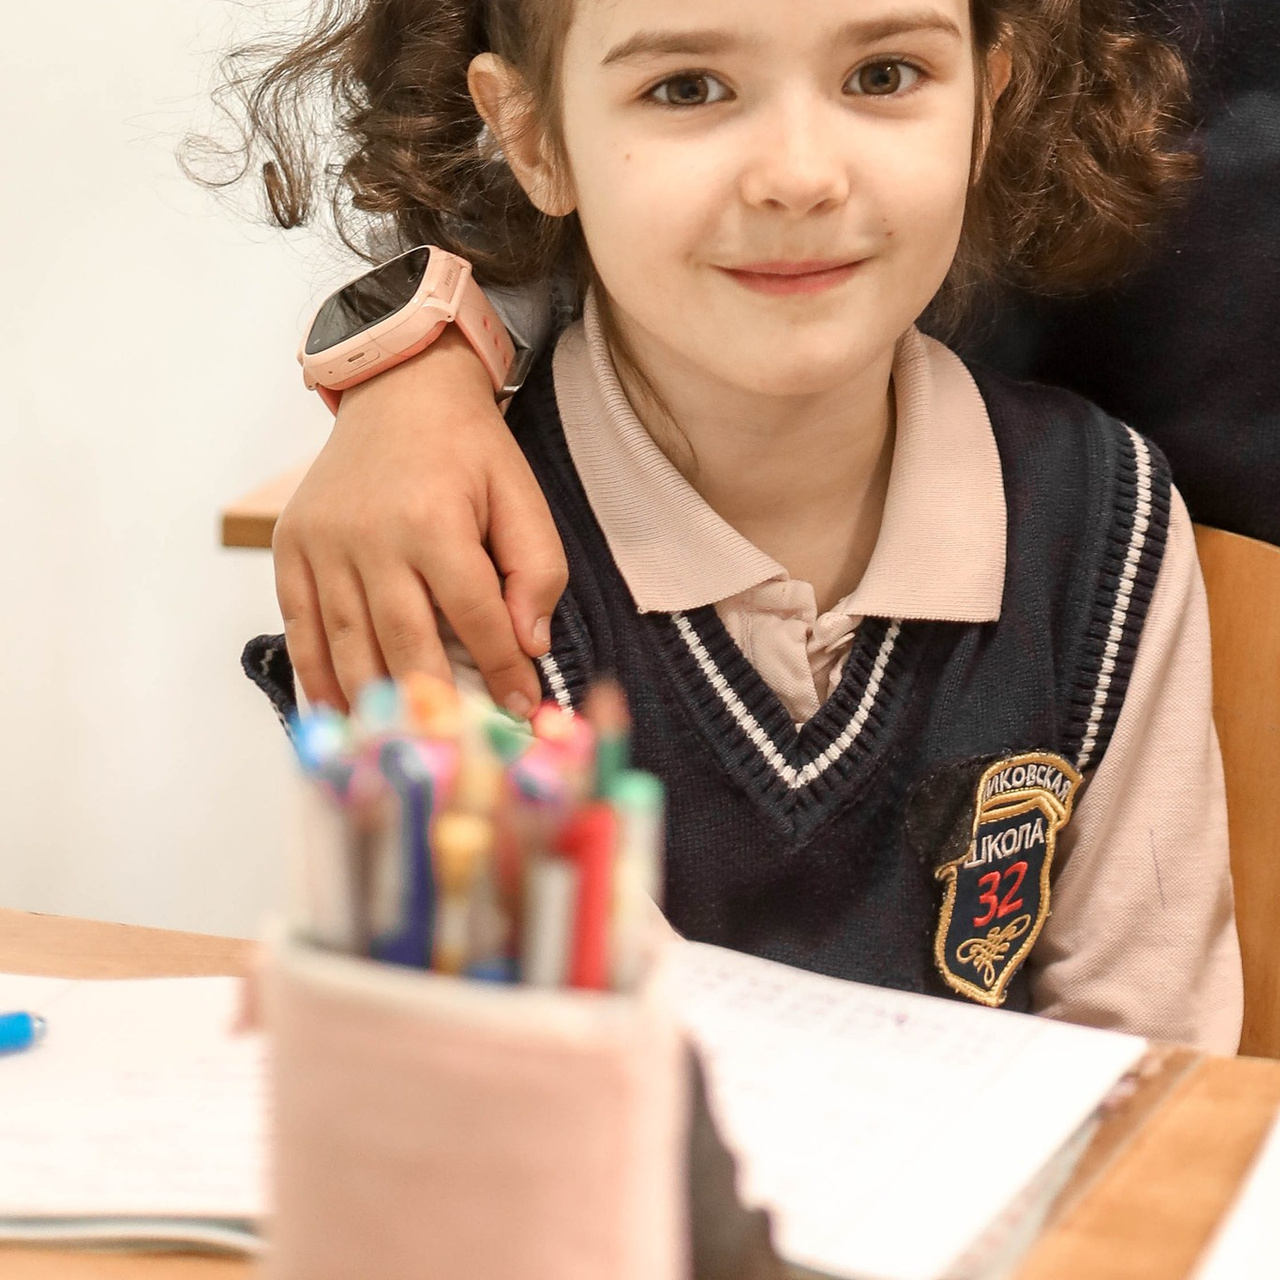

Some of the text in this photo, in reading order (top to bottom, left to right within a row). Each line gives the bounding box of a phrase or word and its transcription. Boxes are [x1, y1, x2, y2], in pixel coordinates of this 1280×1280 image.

[981, 763, 1073, 803] ИКОВСКАЯ
[962, 817, 1045, 870] ШКОЛА
[972, 860, 1029, 928] 32
